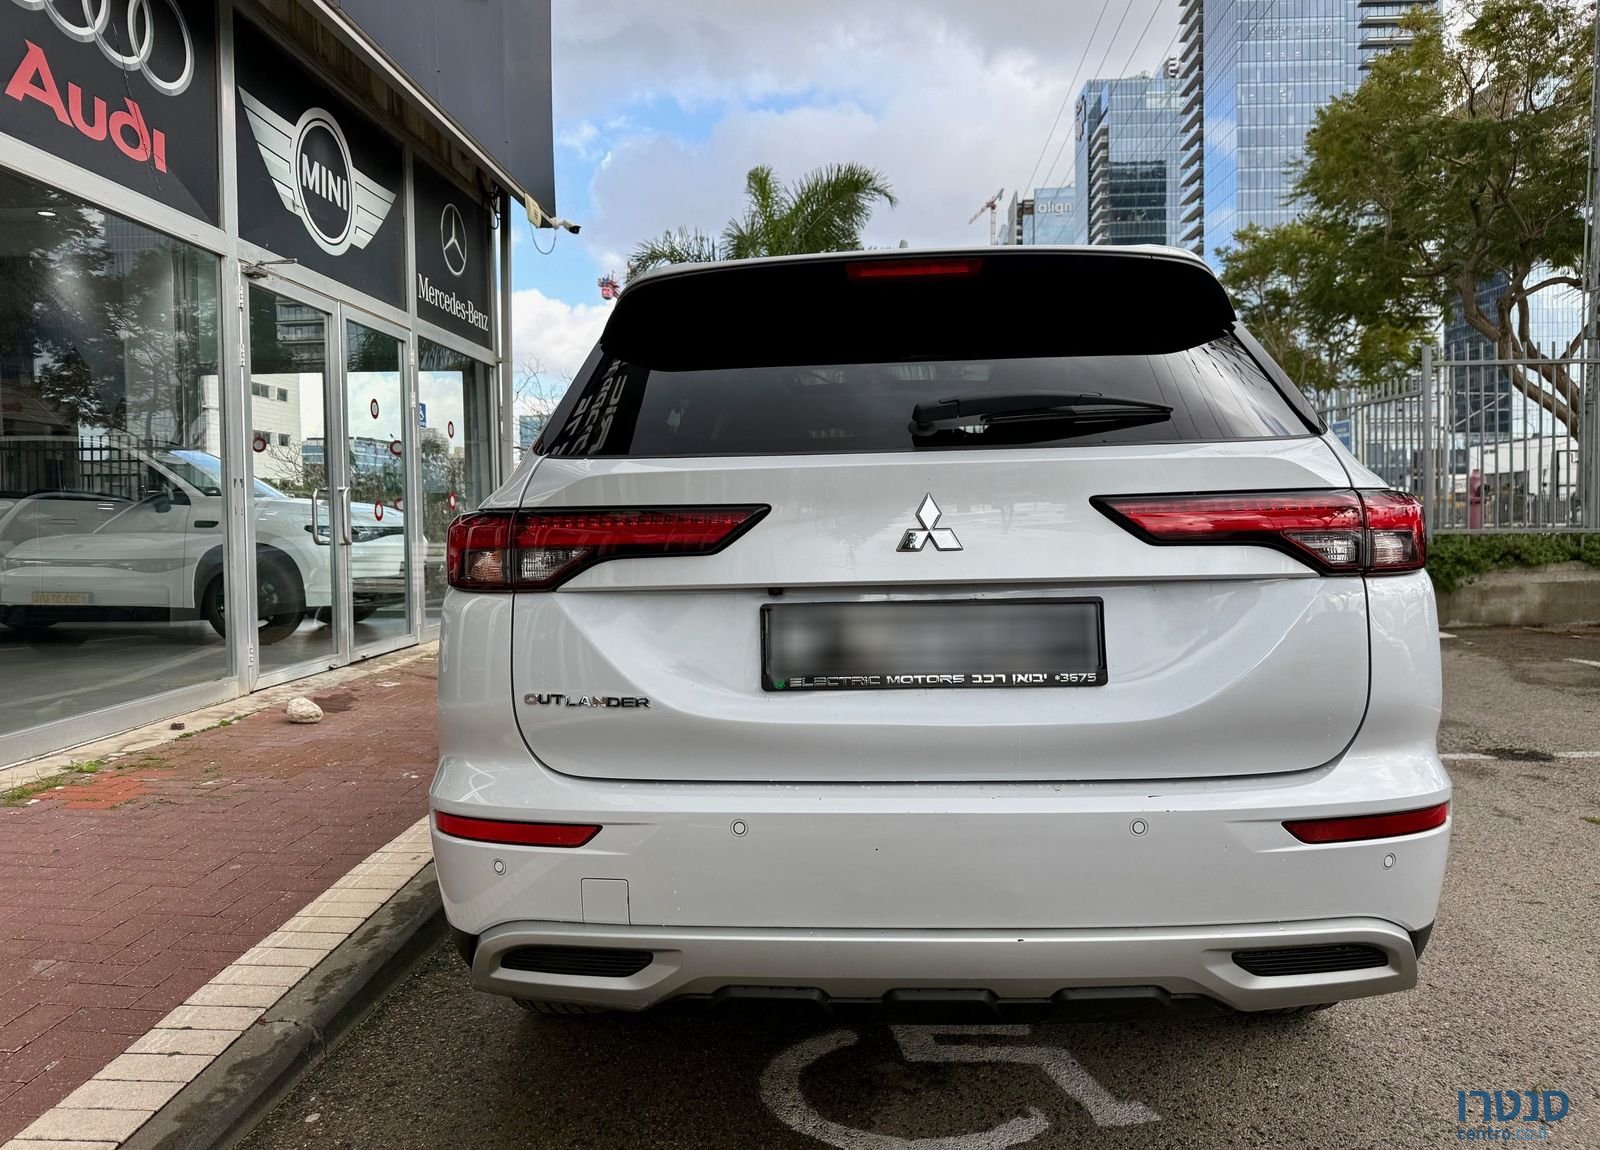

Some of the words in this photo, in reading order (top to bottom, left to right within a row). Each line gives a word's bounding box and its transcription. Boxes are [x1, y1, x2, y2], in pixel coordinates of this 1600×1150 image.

[4, 39, 167, 174] Audi
[302, 152, 348, 212] MINI
[1037, 201, 1073, 217] align
[417, 272, 489, 332] Mercedes-Benz
[789, 676, 881, 688] ELECTRIC
[886, 674, 965, 685] MOTORS
[971, 673, 1006, 684] רכב
[1012, 673, 1048, 685] יבואן
[524, 693, 651, 708] OUTLANDER
